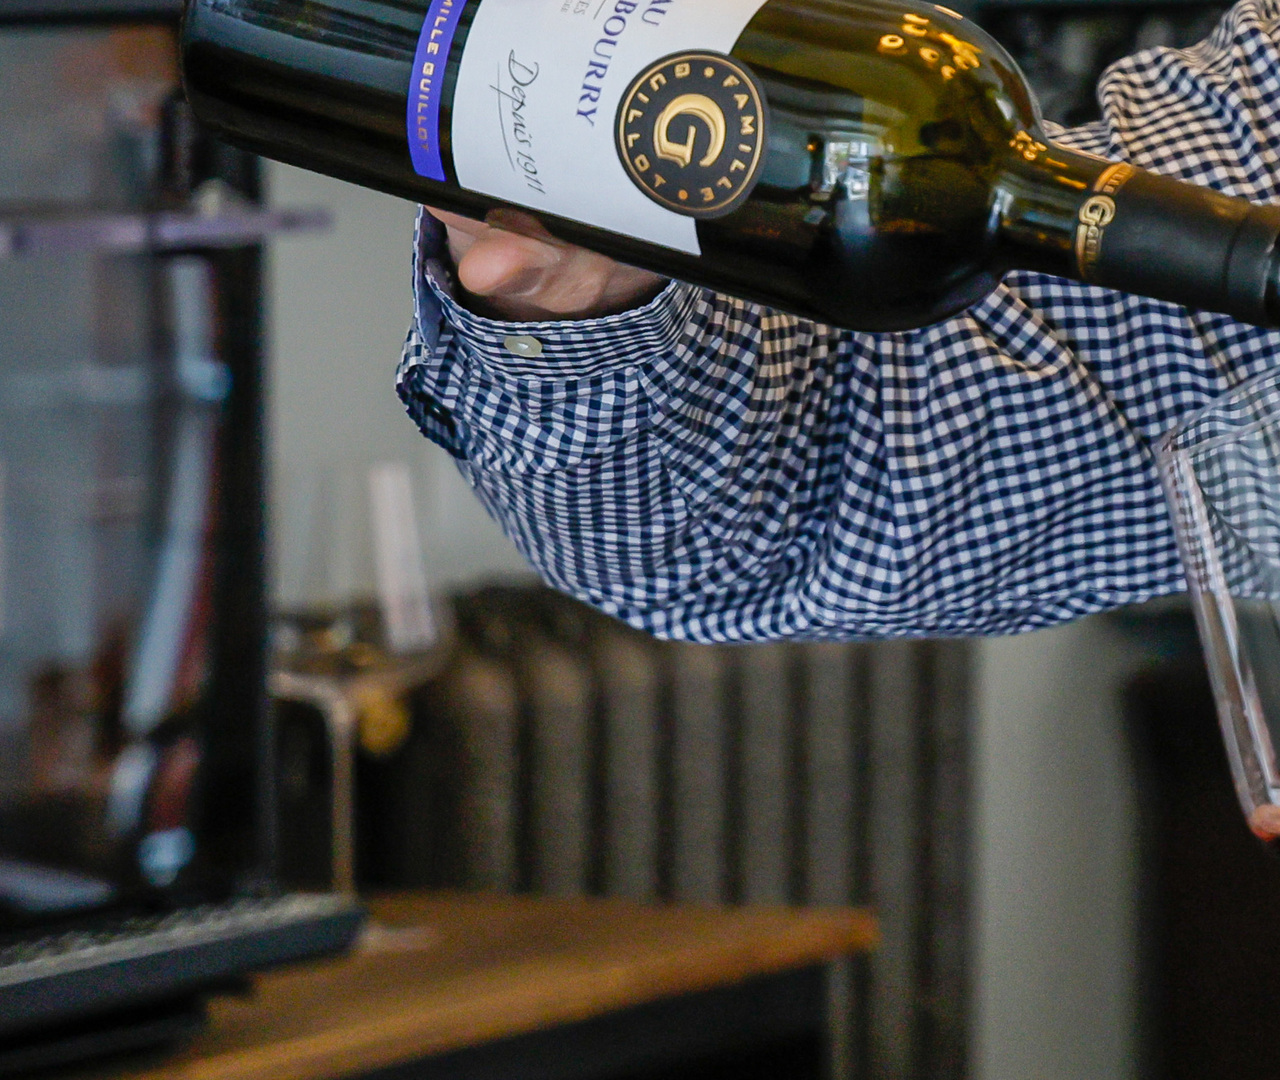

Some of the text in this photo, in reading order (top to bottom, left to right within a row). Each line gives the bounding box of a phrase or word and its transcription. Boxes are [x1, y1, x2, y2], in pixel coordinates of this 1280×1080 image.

[417, 62, 435, 152] GUILLOT
[489, 49, 546, 195] Depuis 1911
[576, 0, 639, 127] BOURRY
[626, 62, 755, 202] FAMILLE GUILLOT
[653, 93, 726, 168] G
